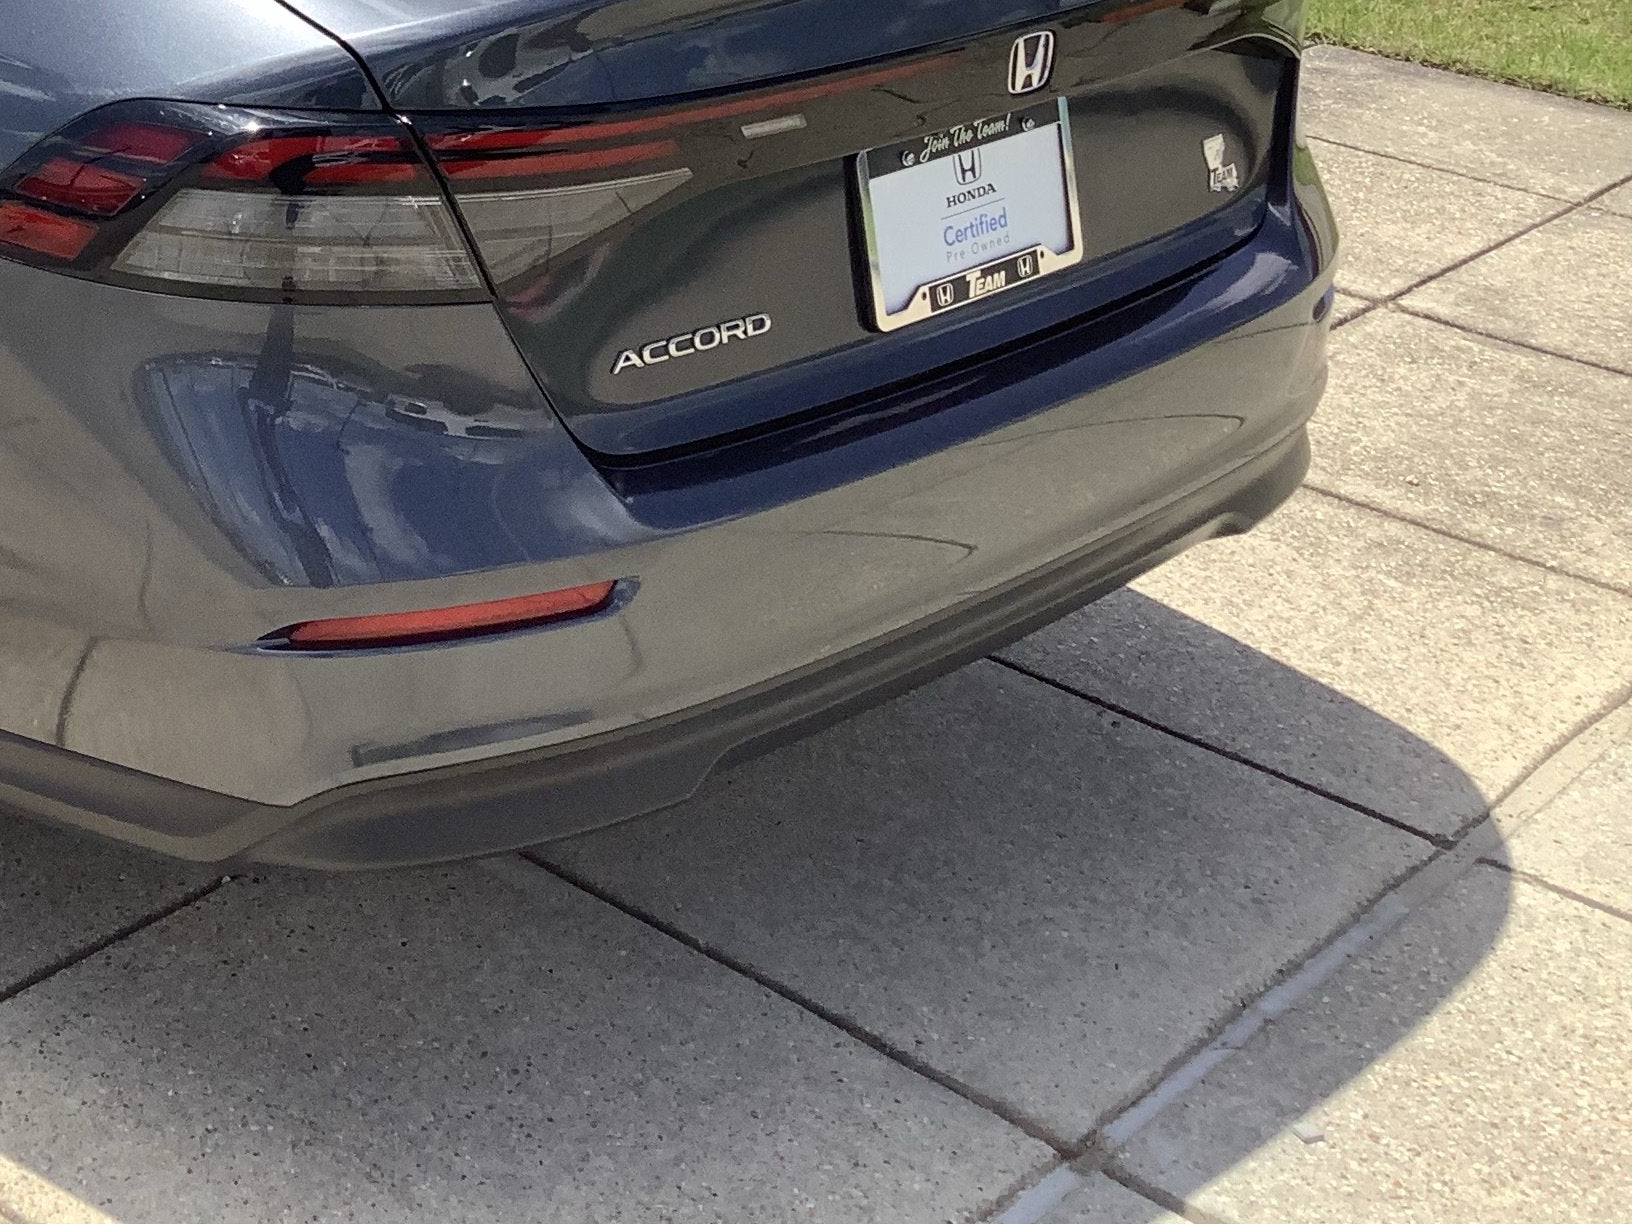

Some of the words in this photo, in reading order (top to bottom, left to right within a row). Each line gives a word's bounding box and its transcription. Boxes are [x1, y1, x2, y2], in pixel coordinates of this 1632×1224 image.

[919, 134, 949, 163] Join
[950, 125, 974, 147] The
[973, 113, 1011, 140] Team!
[946, 183, 997, 208] HONDA
[943, 206, 1008, 246] Certified
[612, 313, 772, 375] ACCORD
